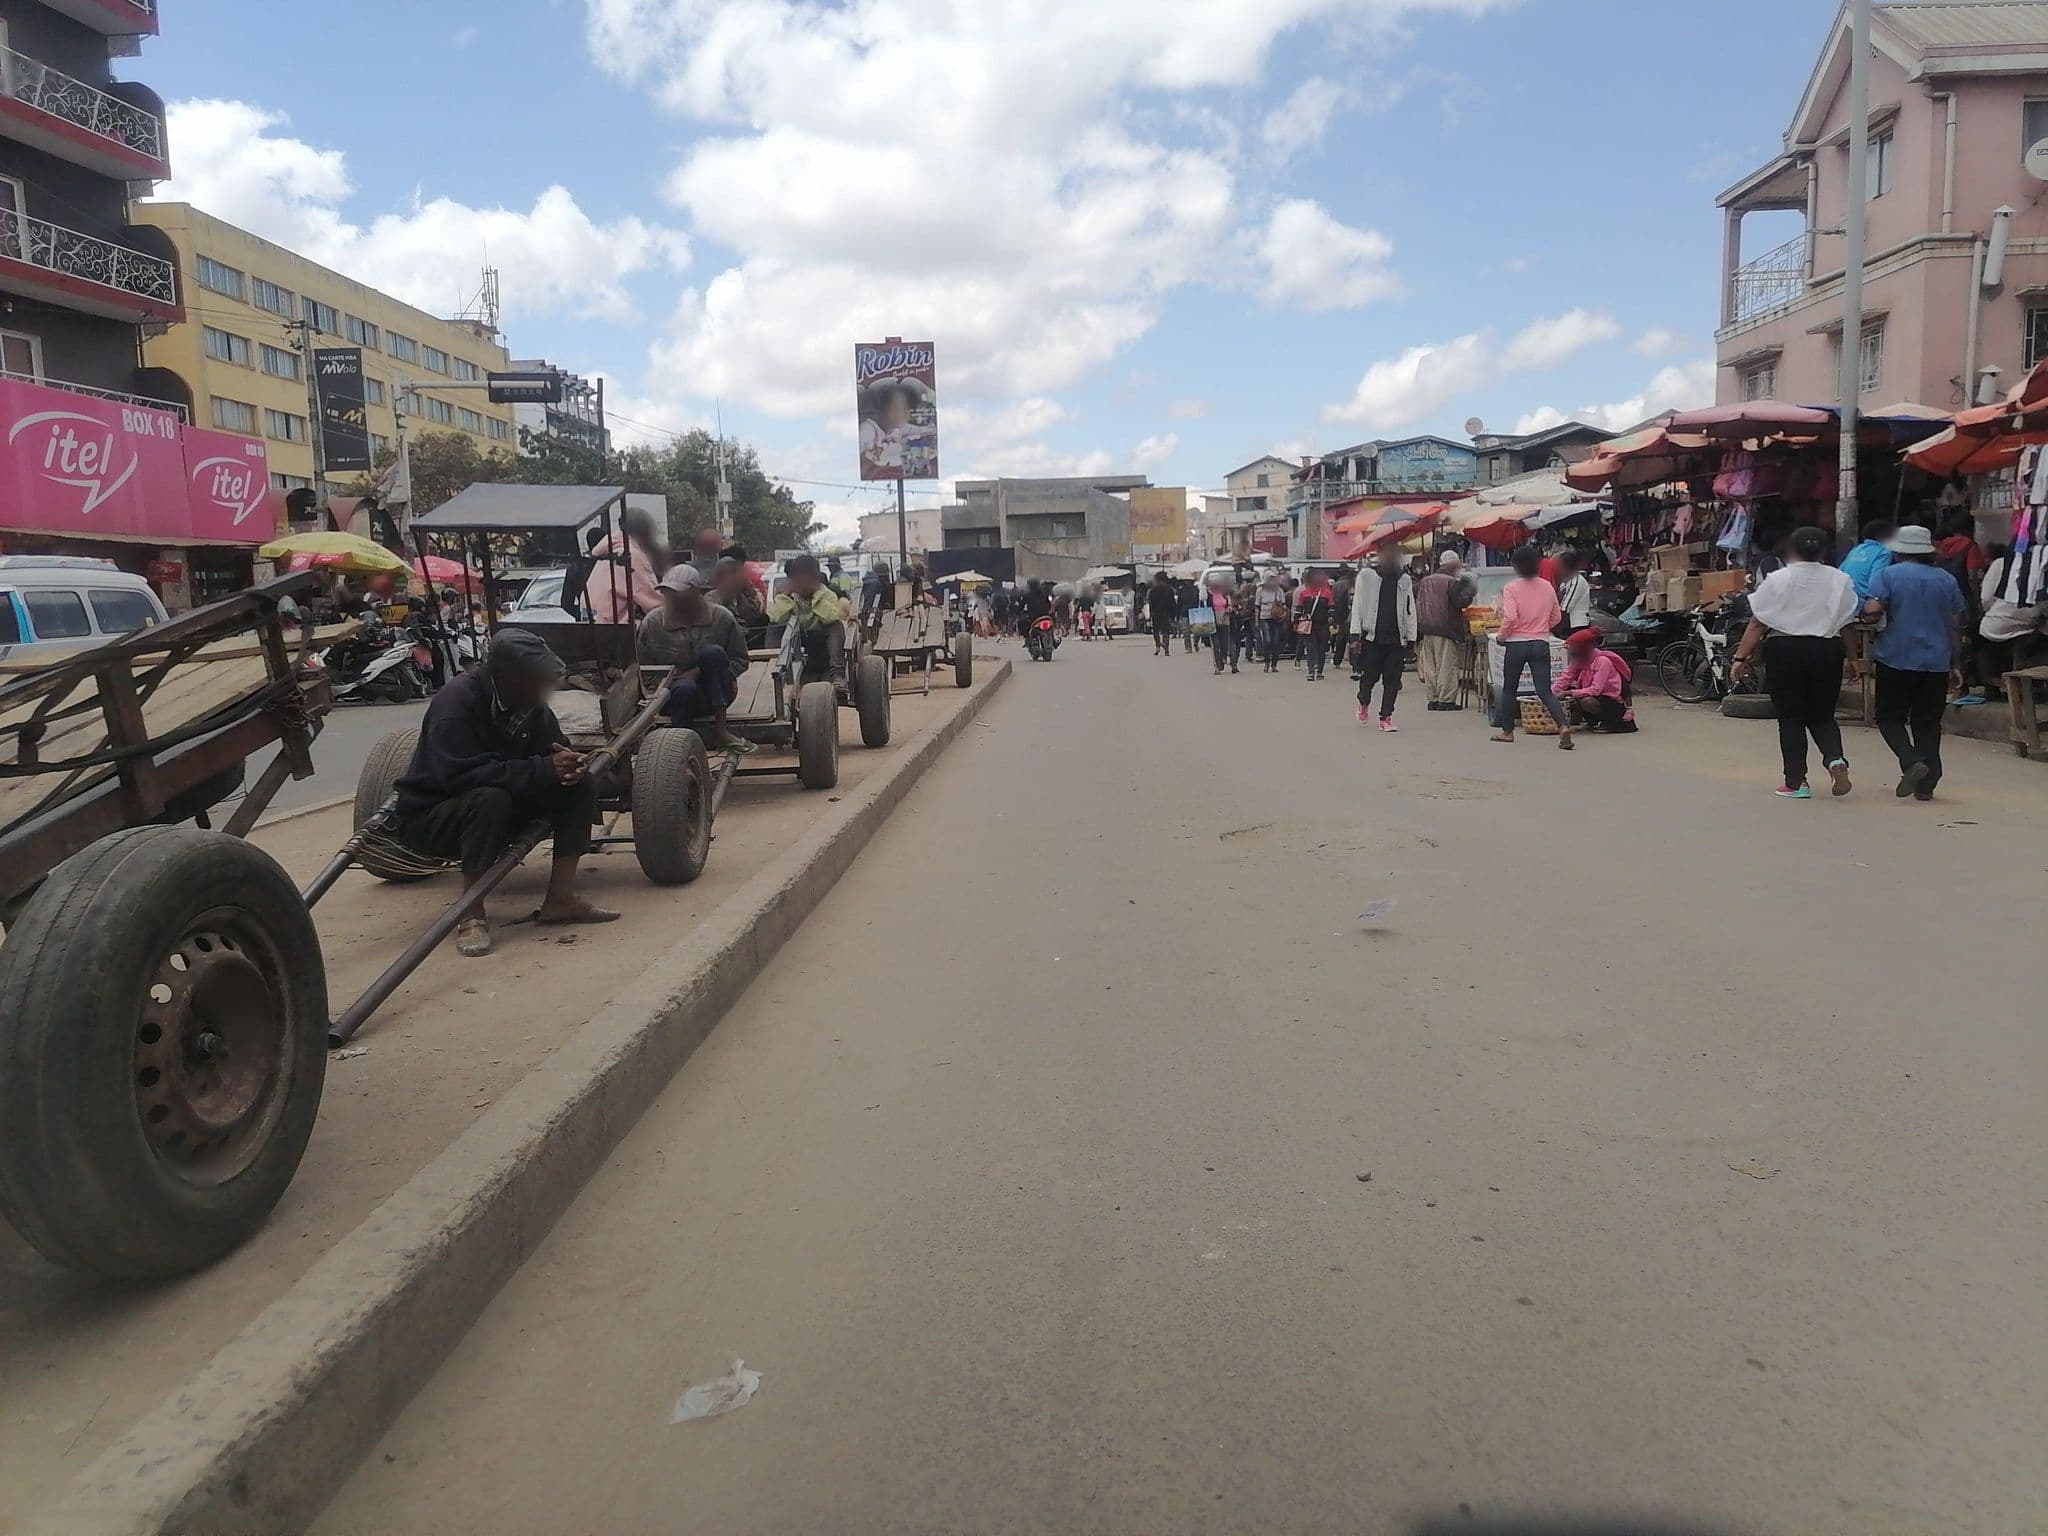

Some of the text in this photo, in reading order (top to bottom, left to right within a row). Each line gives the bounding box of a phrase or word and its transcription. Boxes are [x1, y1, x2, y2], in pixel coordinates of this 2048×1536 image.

[856, 345, 933, 382] Robin
[121, 408, 175, 440] BOX 18
[44, 424, 114, 475] itel
[211, 465, 252, 500] itel
